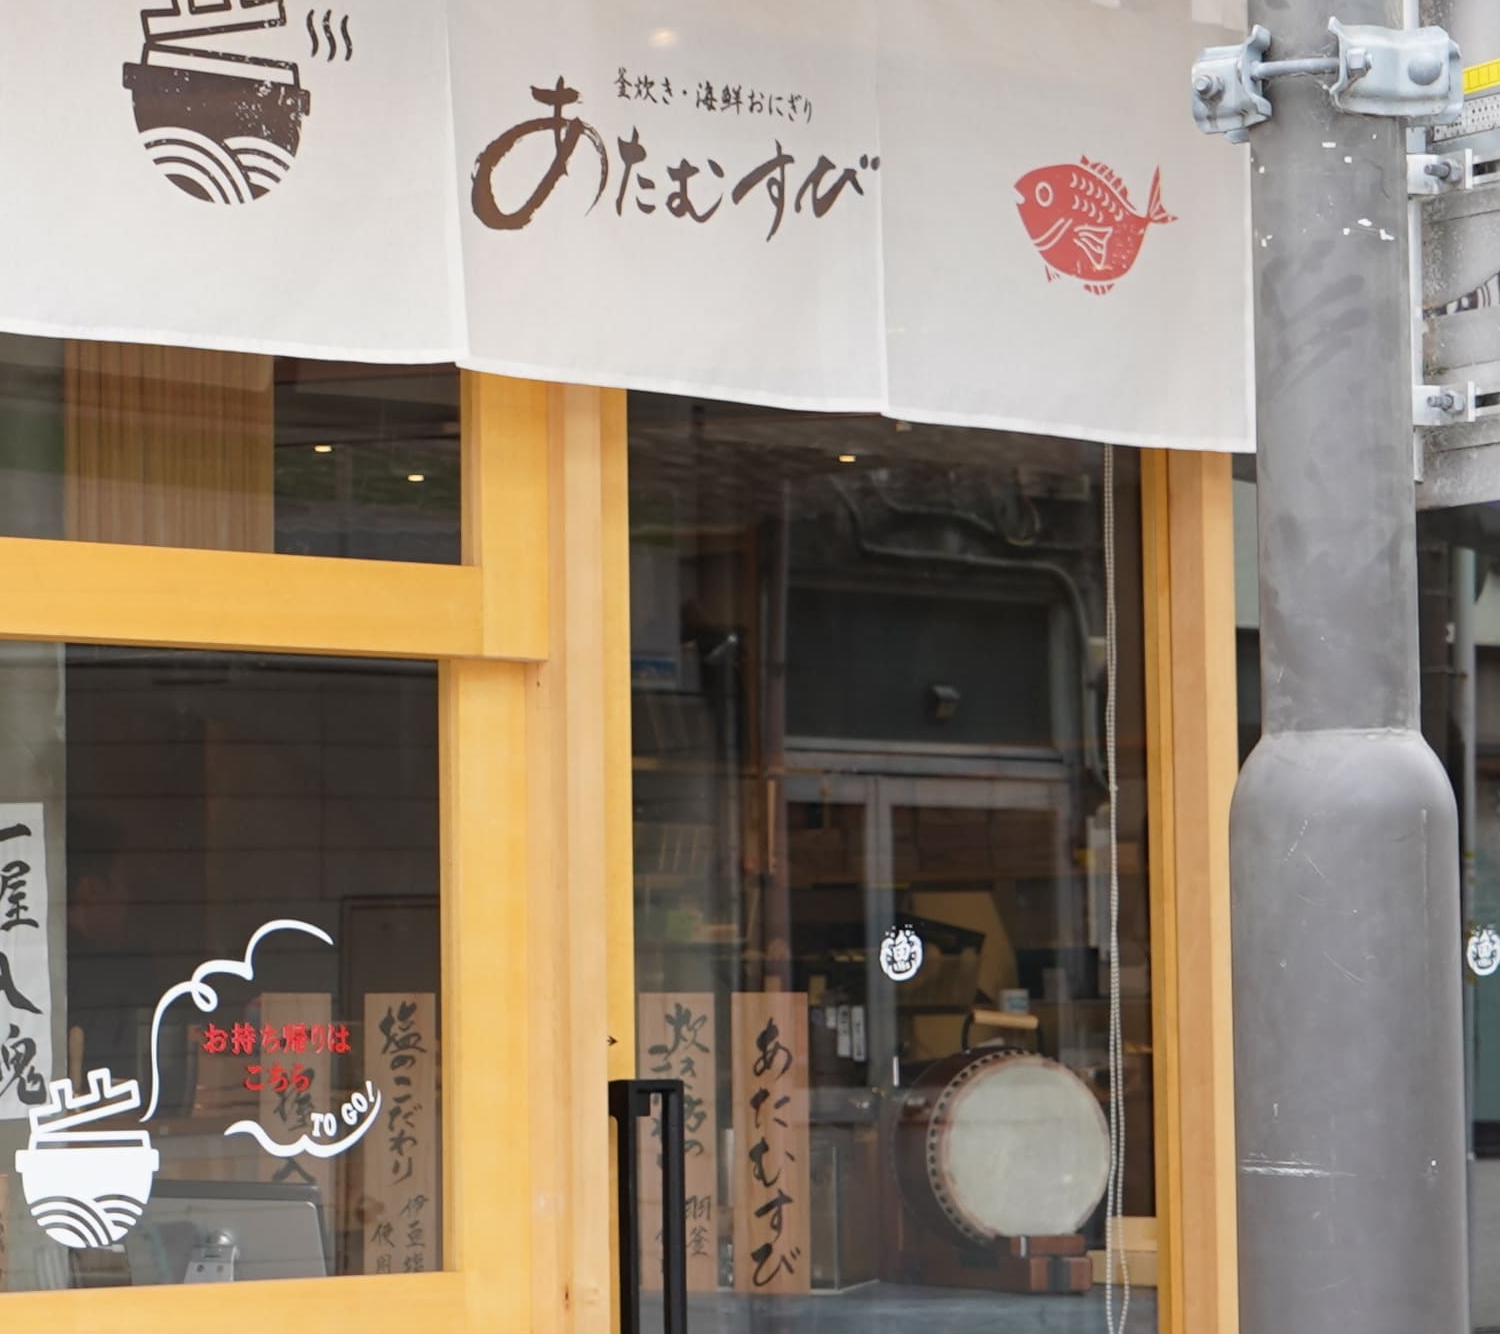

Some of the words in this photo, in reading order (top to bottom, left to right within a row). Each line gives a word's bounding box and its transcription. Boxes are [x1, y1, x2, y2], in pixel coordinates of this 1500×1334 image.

[613, 66, 813, 124] 釜炊き・海鮮おにぎり
[469, 76, 881, 243] あたむすび
[202, 1022, 351, 1055] お持ち帰りは
[243, 1063, 311, 1092] こちら
[311, 1112, 337, 1137] TO
[341, 1080, 375, 1126] GO!
[749, 1017, 802, 1287] あたむすび
